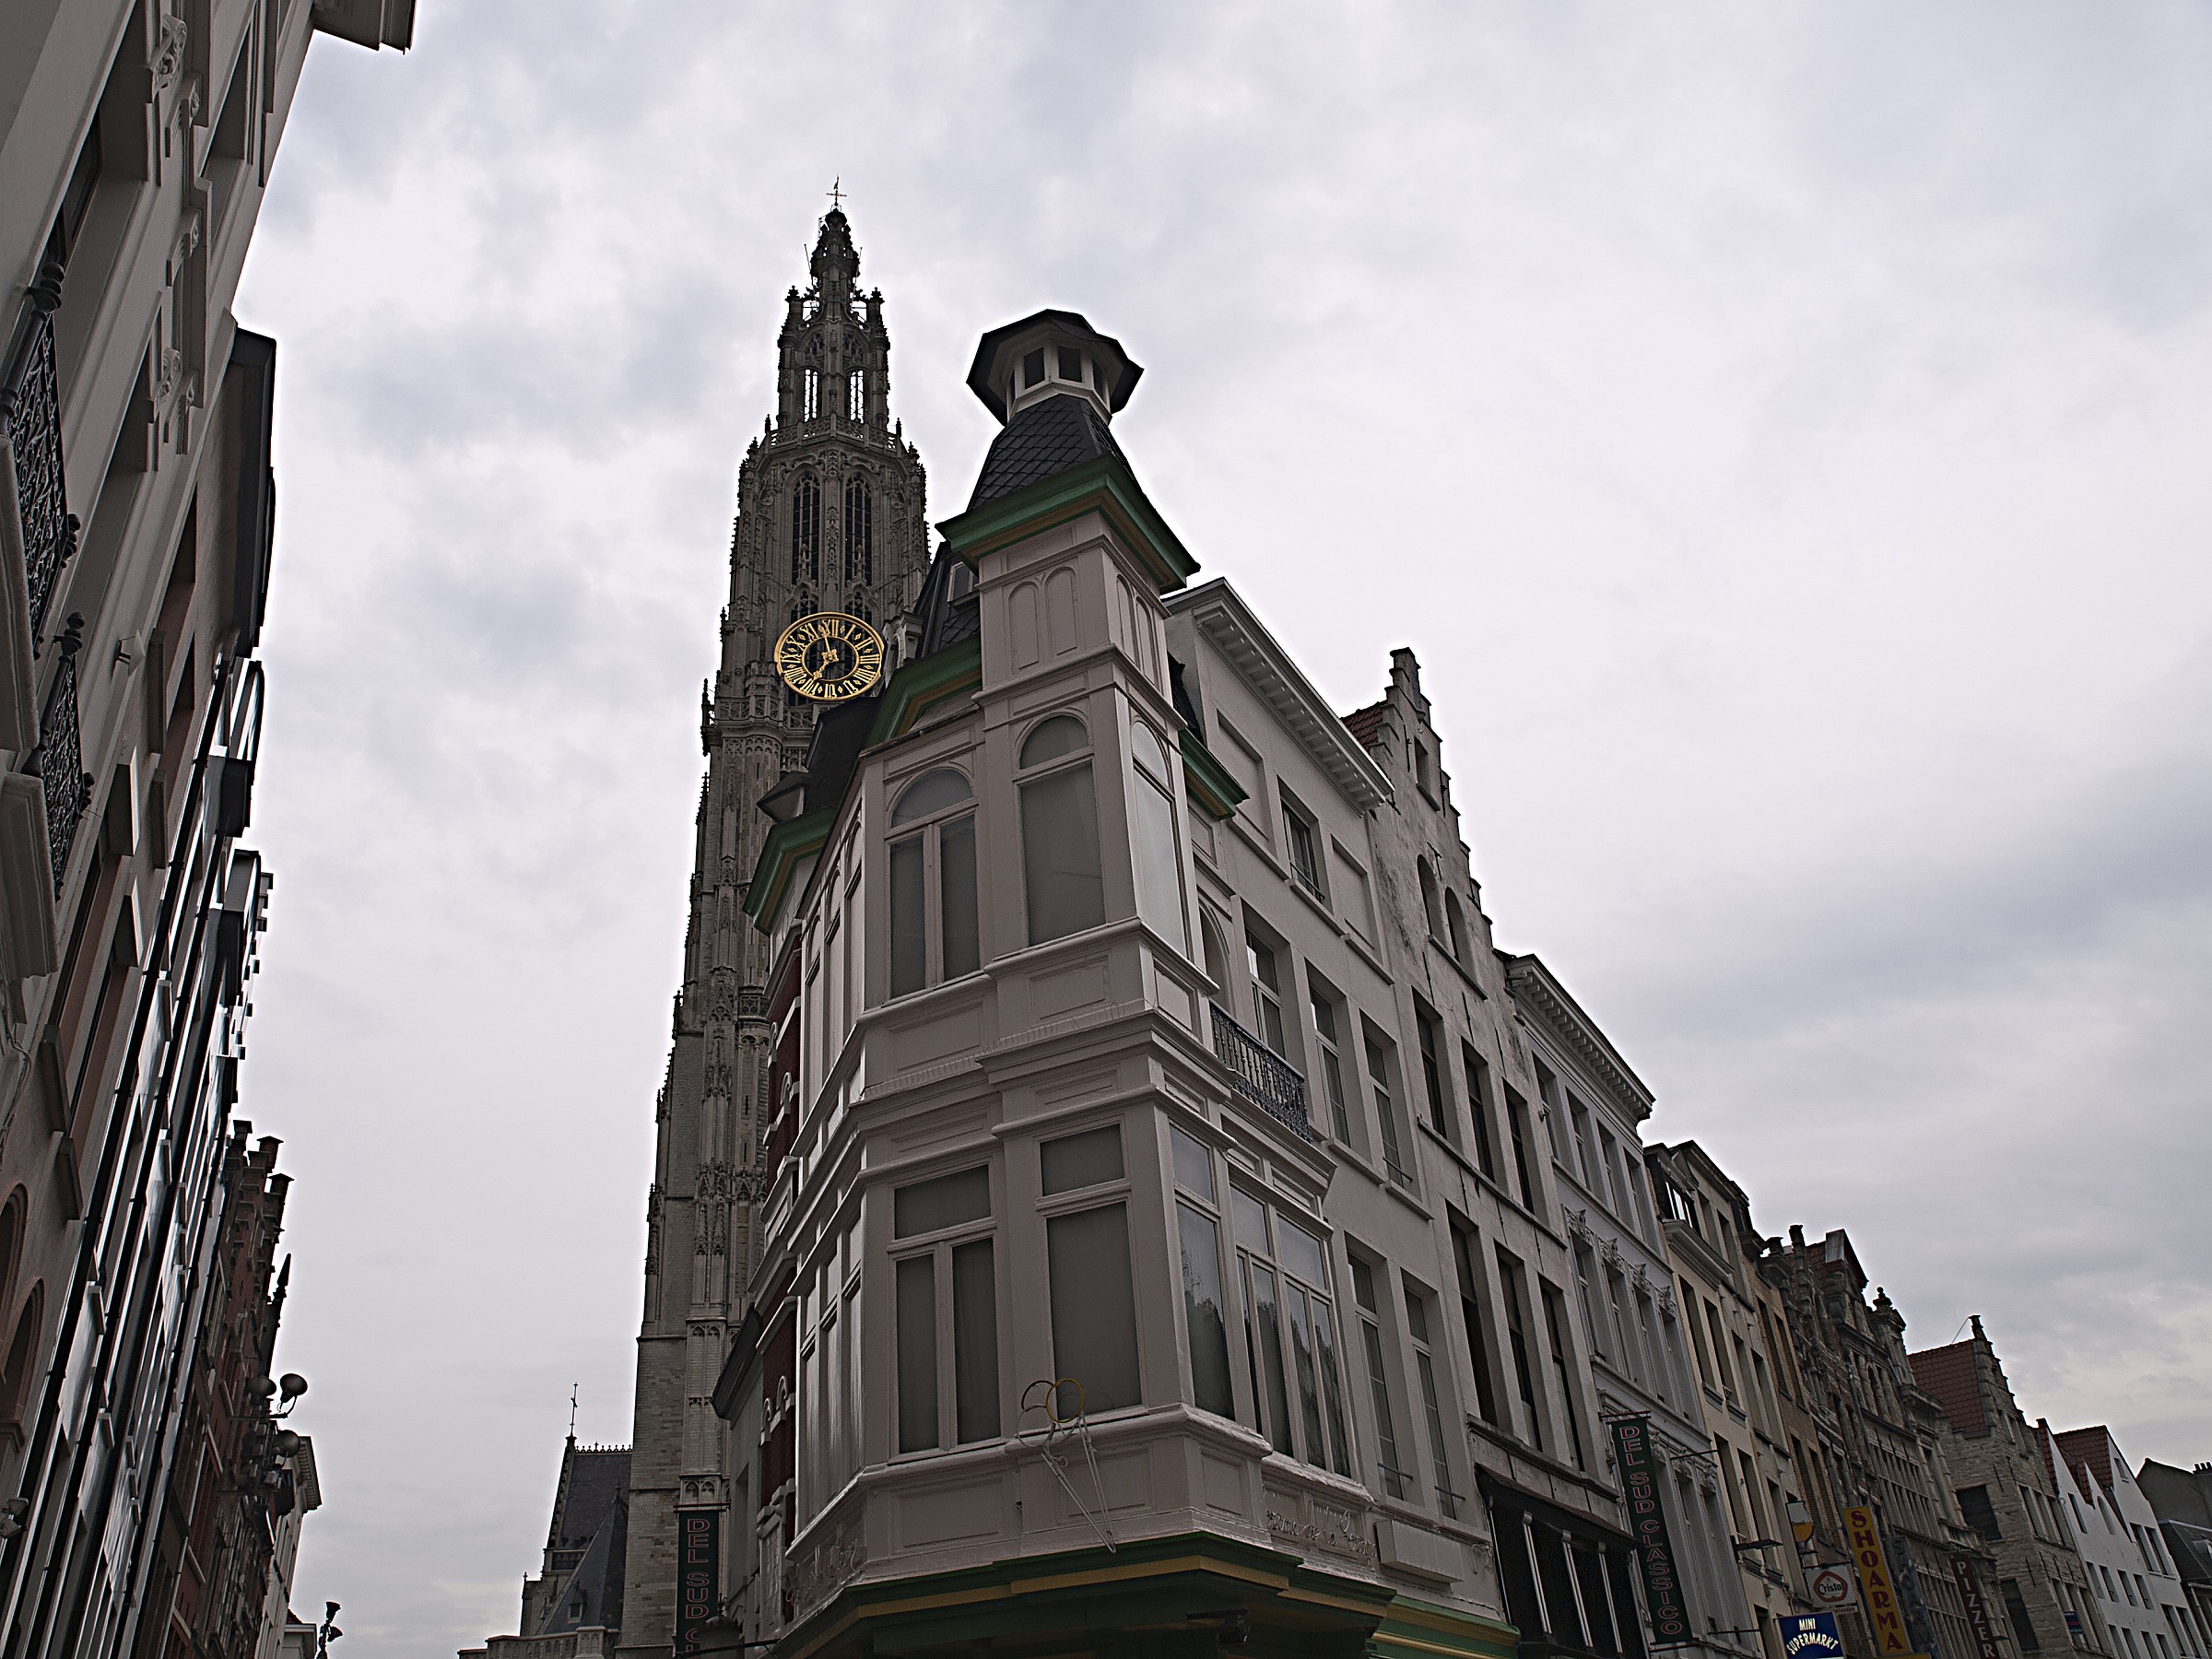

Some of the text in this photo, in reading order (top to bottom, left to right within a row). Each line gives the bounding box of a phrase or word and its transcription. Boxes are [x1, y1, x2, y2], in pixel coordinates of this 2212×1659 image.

[687, 1518, 711, 1564] DEL
[1619, 1426, 1683, 1635] DEL SUD CLASSICO
[685, 1571, 710, 1619] SUD
[1851, 1511, 1904, 1650] SHOARMA
[1798, 1618, 1817, 1631] MINI
[1956, 1561, 1996, 1658] PIZZER
[1786, 1631, 1839, 1655] SUPERMARKT
